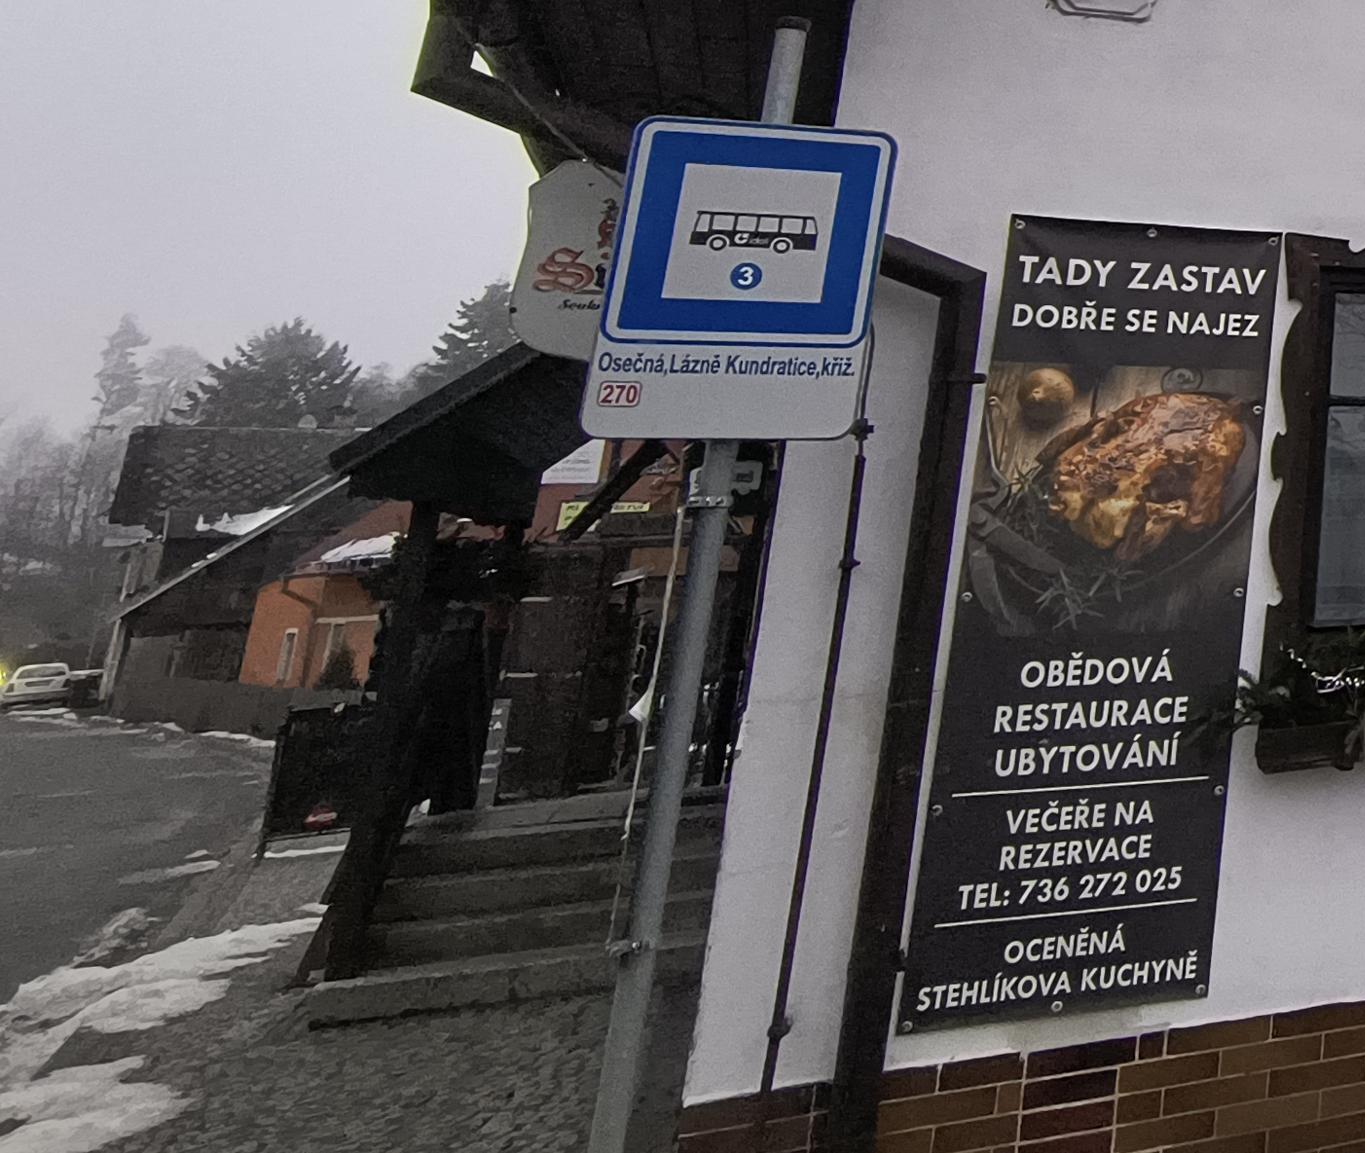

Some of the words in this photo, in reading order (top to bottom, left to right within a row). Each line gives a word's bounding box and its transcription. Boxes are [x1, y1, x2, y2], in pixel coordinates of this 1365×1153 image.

[737, 266, 754, 286] 3
[1018, 254, 1117, 288] TADY
[1127, 261, 1267, 295] ZASTAV
[1011, 300, 1117, 332] DOBŘE
[1125, 308, 1158, 333] SE
[1166, 310, 1260, 337] NAJEZ
[600, 383, 639, 405] 270
[1020, 649, 1174, 689] OBĚDOVÁ
[993, 696, 1189, 733] RESTAURACE
[994, 731, 1182, 778] UBYTOVÁNÍ
[1005, 799, 1106, 835] VEČEŘE
[1114, 799, 1154, 828] NA
[999, 834, 1153, 872] REZERVACE
[958, 883, 1011, 910] TEL:
[1018, 878, 1070, 906] 736
[1079, 872, 1126, 900] 272
[1135, 866, 1183, 894] 025
[1003, 923, 1127, 964] OCENĚNÁ
[915, 971, 1072, 1012] STEHLÍKOVA
[1080, 950, 1198, 992] KUCHYNĚ
